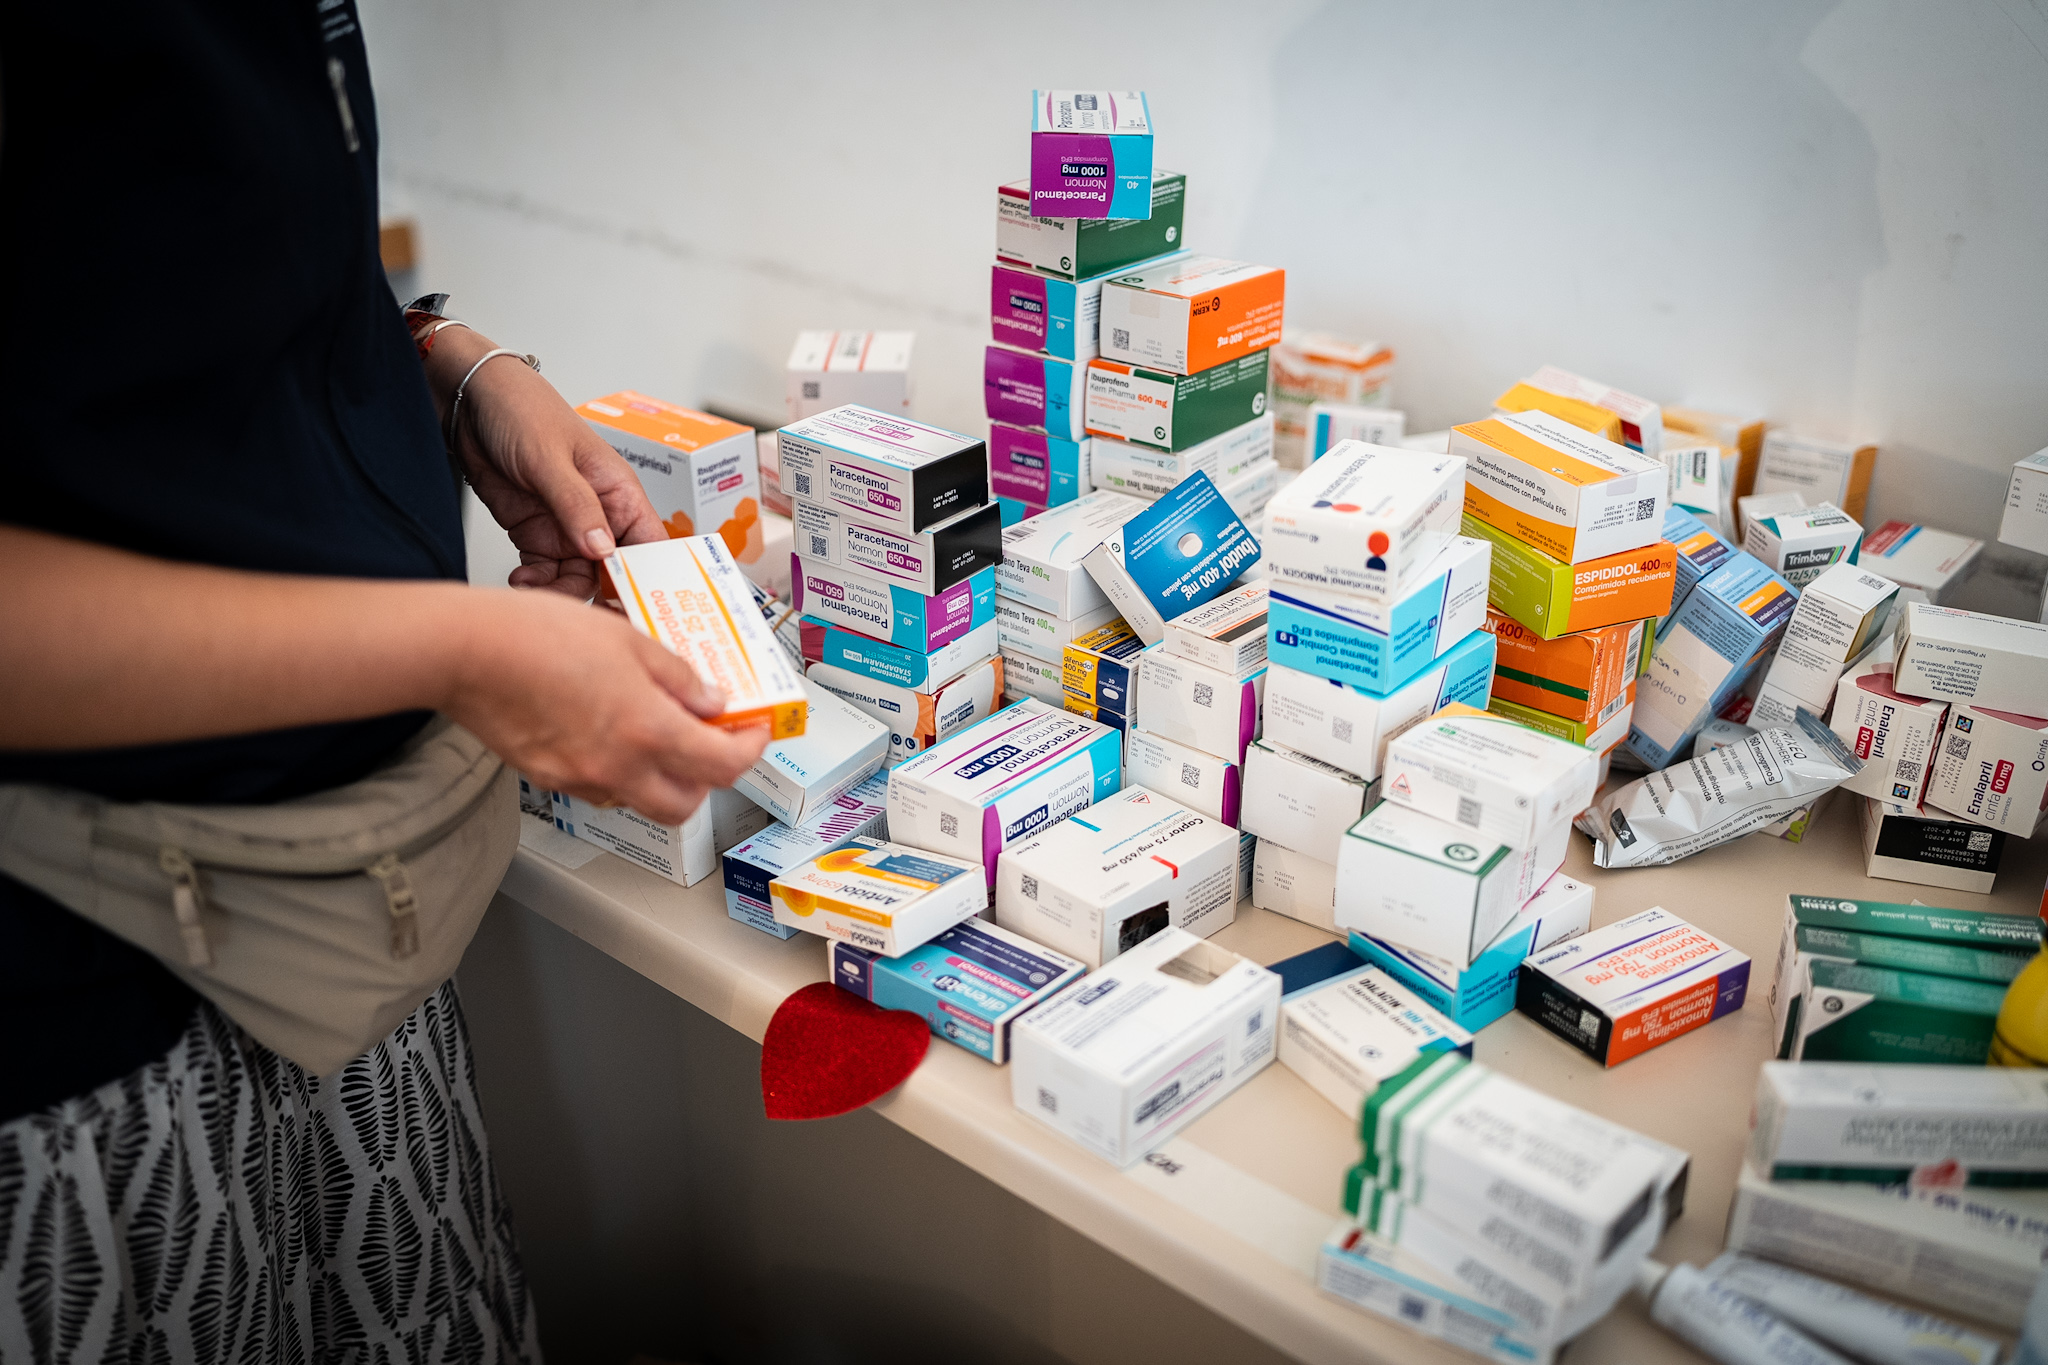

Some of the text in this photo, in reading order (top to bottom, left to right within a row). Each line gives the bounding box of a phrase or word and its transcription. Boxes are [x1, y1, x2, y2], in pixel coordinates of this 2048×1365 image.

[1081, 164, 1106, 175] 1000
[1065, 179, 1107, 189] Normon
[1126, 180, 1138, 190] 40
[1035, 191, 1106, 202] Paracetamol
[1040, 217, 1052, 226] 650
[1024, 300, 1042, 312] 1000
[1192, 303, 1210, 316] KERN
[1056, 321, 1066, 329] 40
[1229, 332, 1243, 344] 600
[1090, 372, 1130, 388] Ibuprofeno
[1090, 382, 1153, 403] Kern Pharma 600
[827, 412, 869, 431] Normon
[839, 409, 911, 432] Paracetamol
[1534, 424, 1602, 456] Ibuprofeno 600
[830, 464, 889, 492] Paracetamol
[1476, 456, 1538, 488] Ibuprofeno pensa 600
[830, 478, 901, 511] Normon 650 mg
[1126, 480, 1141, 491] Teva
[1489, 472, 1554, 511] recubiertos con película
[830, 491, 858, 504] comprimidos
[848, 527, 909, 553] Paracetamol
[1308, 534, 1319, 543] 40
[703, 536, 721, 564] NORMON
[848, 540, 921, 572] Normon 650 mg
[848, 552, 877, 565] comprimidos
[1788, 550, 1830, 566] Trimbow
[1017, 559, 1030, 574] Teva
[1161, 529, 1245, 598] comprimidos recubiertos película
[1575, 558, 1660, 586] ESPIDIDOL 400
[1004, 570, 1025, 584] blandas
[1282, 570, 1386, 596] Paracetamol MABOGEN
[1574, 570, 1671, 595] Comprimidos recubiertos
[808, 578, 888, 614] 650 mg Normon
[856, 584, 888, 599] comprimidos
[980, 596, 988, 604] 40
[1573, 594, 1598, 602] Ibuprofeno
[821, 598, 888, 629] Paracetamol
[946, 606, 970, 621] Normon
[1183, 589, 1258, 625] Enantyum 25
[1800, 603, 1854, 630] solución inhalación
[1808, 600, 1838, 617] microgramos
[682, 615, 704, 633] 25
[903, 618, 913, 626] 40
[1021, 612, 1036, 626] Teva
[1199, 607, 1238, 628] comprimidos
[1823, 617, 1842, 630] presión
[930, 615, 970, 641] Paracetamol
[1001, 633, 1008, 641] 20
[1009, 623, 1030, 636] blandas
[1393, 618, 1421, 643] Paracetamol
[1496, 622, 1523, 640] 400
[1789, 628, 1808, 642] MÉDICA
[1793, 619, 1849, 648] MEDICAMENTO SUJETO
[1795, 626, 1831, 646] PRESCRIPCIÓN
[1314, 628, 1380, 652] comprimidos
[1498, 638, 1536, 653] sabor menta
[877, 652, 911, 668] comprimidos
[1300, 639, 1380, 666] Pharma Combix
[1956, 649, 1978, 657] Registro
[863, 656, 912, 676] STADAPHARM
[1025, 662, 1040, 676] Teva
[1064, 656, 1094, 671] difenadol
[1316, 656, 1379, 679] Paracetamol
[1928, 668, 1956, 677] Boulevard
[1954, 660, 1983, 670] Dinamarca
[870, 667, 911, 684] Paracetamol
[1063, 670, 1086, 682] comprimidos
[1925, 673, 1977, 687] Copenhagen Towers
[1098, 680, 1124, 692] comprimidos
[1588, 664, 1601, 719] ESPIDIFEN
[1932, 686, 1954, 694] Pharma
[1941, 682, 1977, 692] Netherlands
[855, 692, 877, 705] STADA
[940, 697, 973, 723] Paracetamol
[1854, 696, 1864, 724] comprimidos
[941, 718, 957, 732] STADA
[1016, 713, 1057, 737] comprimidos
[1862, 699, 1878, 742] cinfa 10
[1017, 717, 1074, 746] Normon
[1872, 704, 1895, 759] Enalapril
[986, 745, 1019, 766] 1000
[1000, 724, 1092, 773] Paracetamol
[775, 752, 808, 778] ESTEVE
[1059, 770, 1090, 793] comprimidos
[1102, 778, 1112, 786] 40
[1967, 761, 1994, 817] Enalapril
[1052, 783, 1090, 811] Normon
[1985, 777, 2006, 821] cinfa 10
[616, 808, 650, 830] 30 cápsulas
[770, 801, 789, 817] ESTEVE
[1024, 806, 1048, 829] 1000
[2000, 797, 2013, 825] comprimidos
[1169, 819, 1204, 838] Captor
[657, 835, 669, 845] Oral
[760, 857, 783, 870] NORMON
[801, 872, 902, 906] Antidol 650mg
[858, 879, 914, 895] comprimidos
[1800, 902, 1836, 912] KERN
[825, 921, 885, 949] Antidol 650mg
[1622, 928, 1691, 958] comprimidos
[1619, 934, 1707, 976] Normon 750
[1636, 942, 1720, 980] Amoxicilina
[959, 961, 1028, 996] paracetamol
[1463, 971, 1499, 995] Paracetamol
[1359, 978, 1401, 1008] DALACIN
[1661, 984, 1716, 1013] comprimidos
[1401, 1009, 1422, 1027] 300
[1643, 994, 1714, 1033] Normon 750
[1648, 1008, 1712, 1040] Amoxicilina
